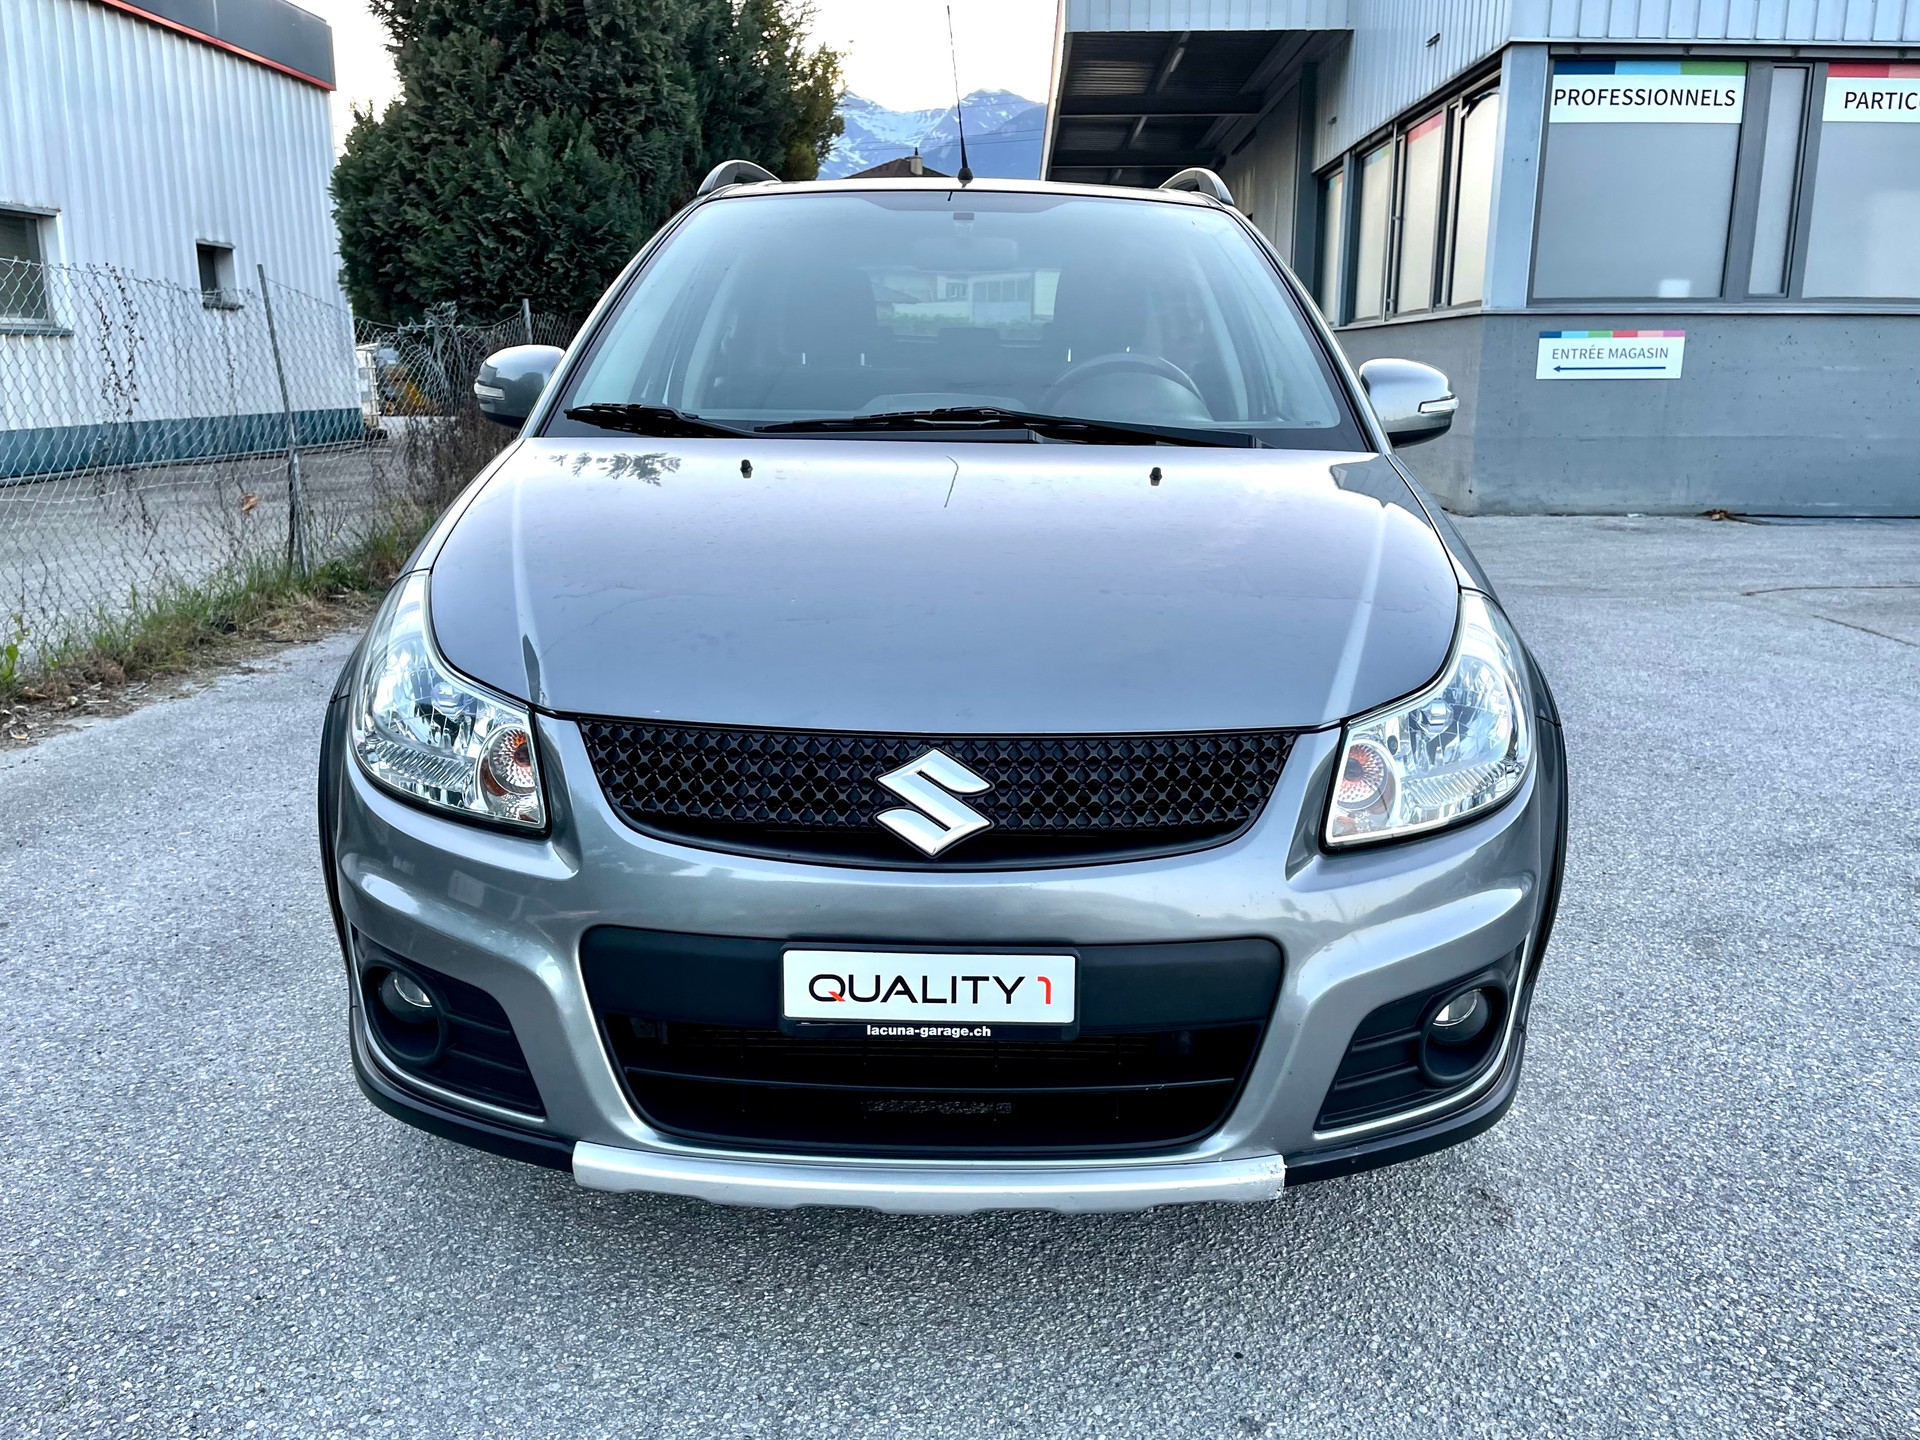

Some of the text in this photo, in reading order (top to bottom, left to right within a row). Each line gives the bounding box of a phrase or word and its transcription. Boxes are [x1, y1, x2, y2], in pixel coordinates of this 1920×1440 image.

[1553, 88, 1737, 107] PROFESSIONNELS
[1844, 91, 1920, 110] PARTIC
[1552, 344, 1669, 360] ENTRÉE MAGASIN
[808, 973, 1052, 1005] QUALITY 1
[866, 1024, 991, 1039] lacuna-garage.ch
